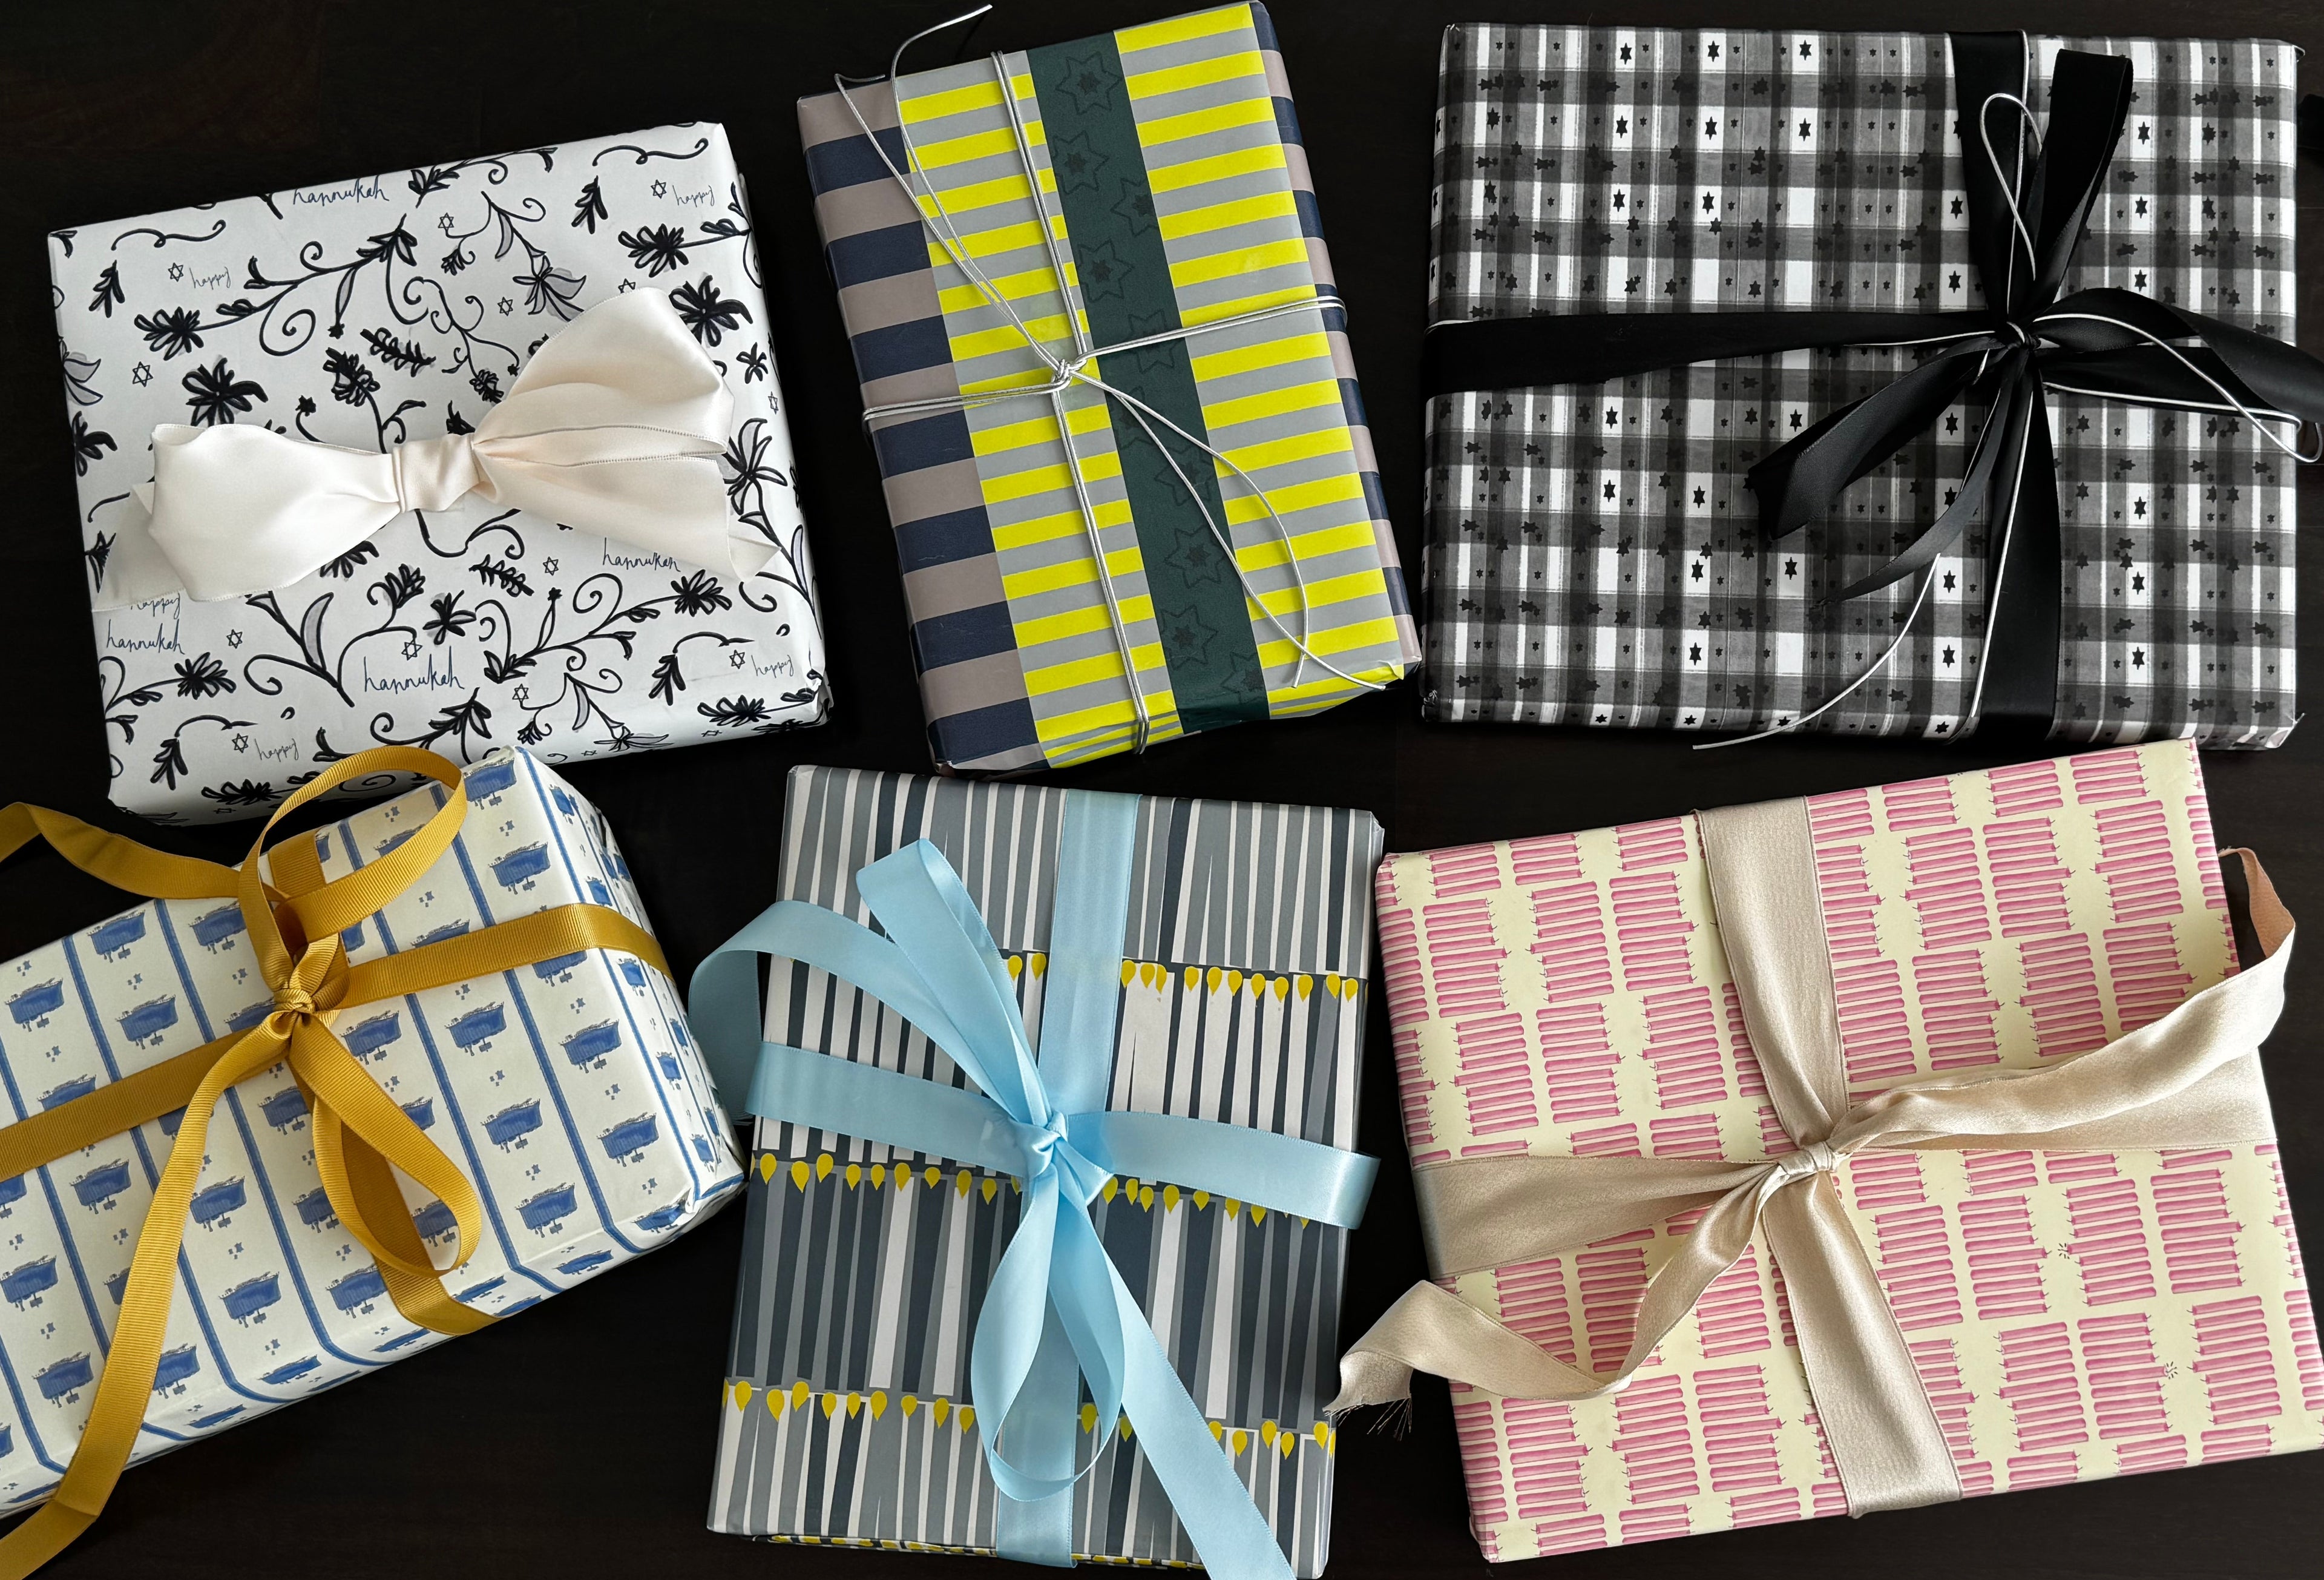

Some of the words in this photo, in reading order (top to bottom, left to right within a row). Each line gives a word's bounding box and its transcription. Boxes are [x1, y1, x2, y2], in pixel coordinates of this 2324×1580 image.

[672, 185, 715, 208] happy
[189, 266, 231, 290] happy
[131, 593, 180, 619] appy
[750, 654, 794, 679] happy
[254, 738, 299, 762] happy
